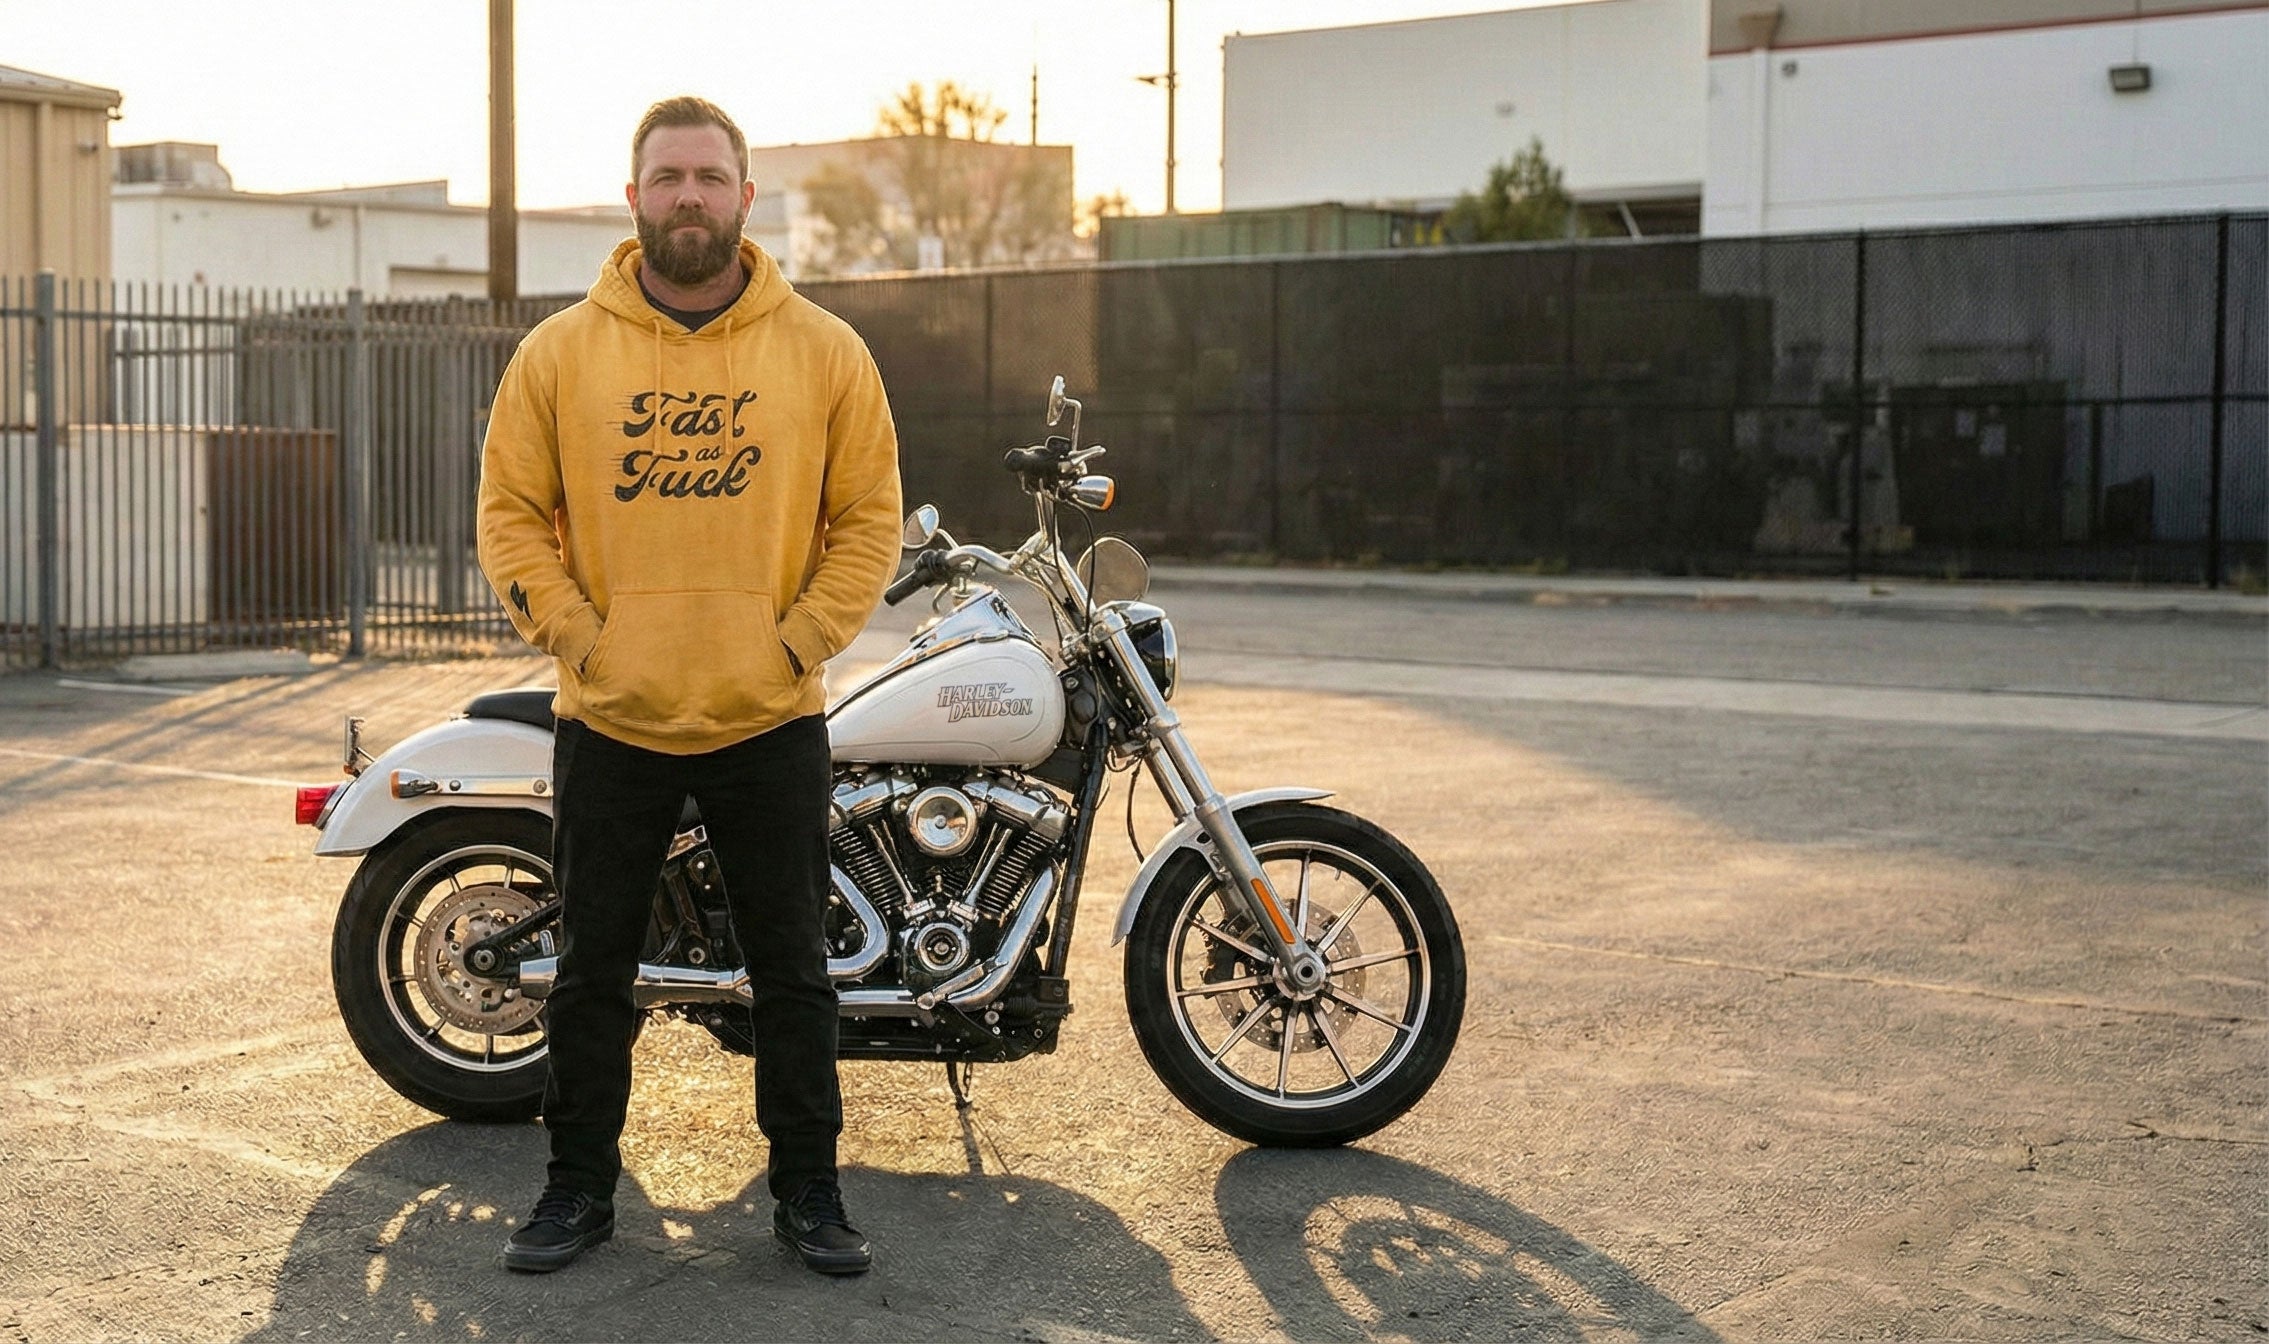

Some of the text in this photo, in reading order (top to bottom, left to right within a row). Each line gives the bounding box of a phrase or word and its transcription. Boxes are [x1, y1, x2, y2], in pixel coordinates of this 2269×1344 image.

[623, 390, 758, 438] Fast
[614, 445, 762, 502] Fuck
[695, 446, 723, 462] as
